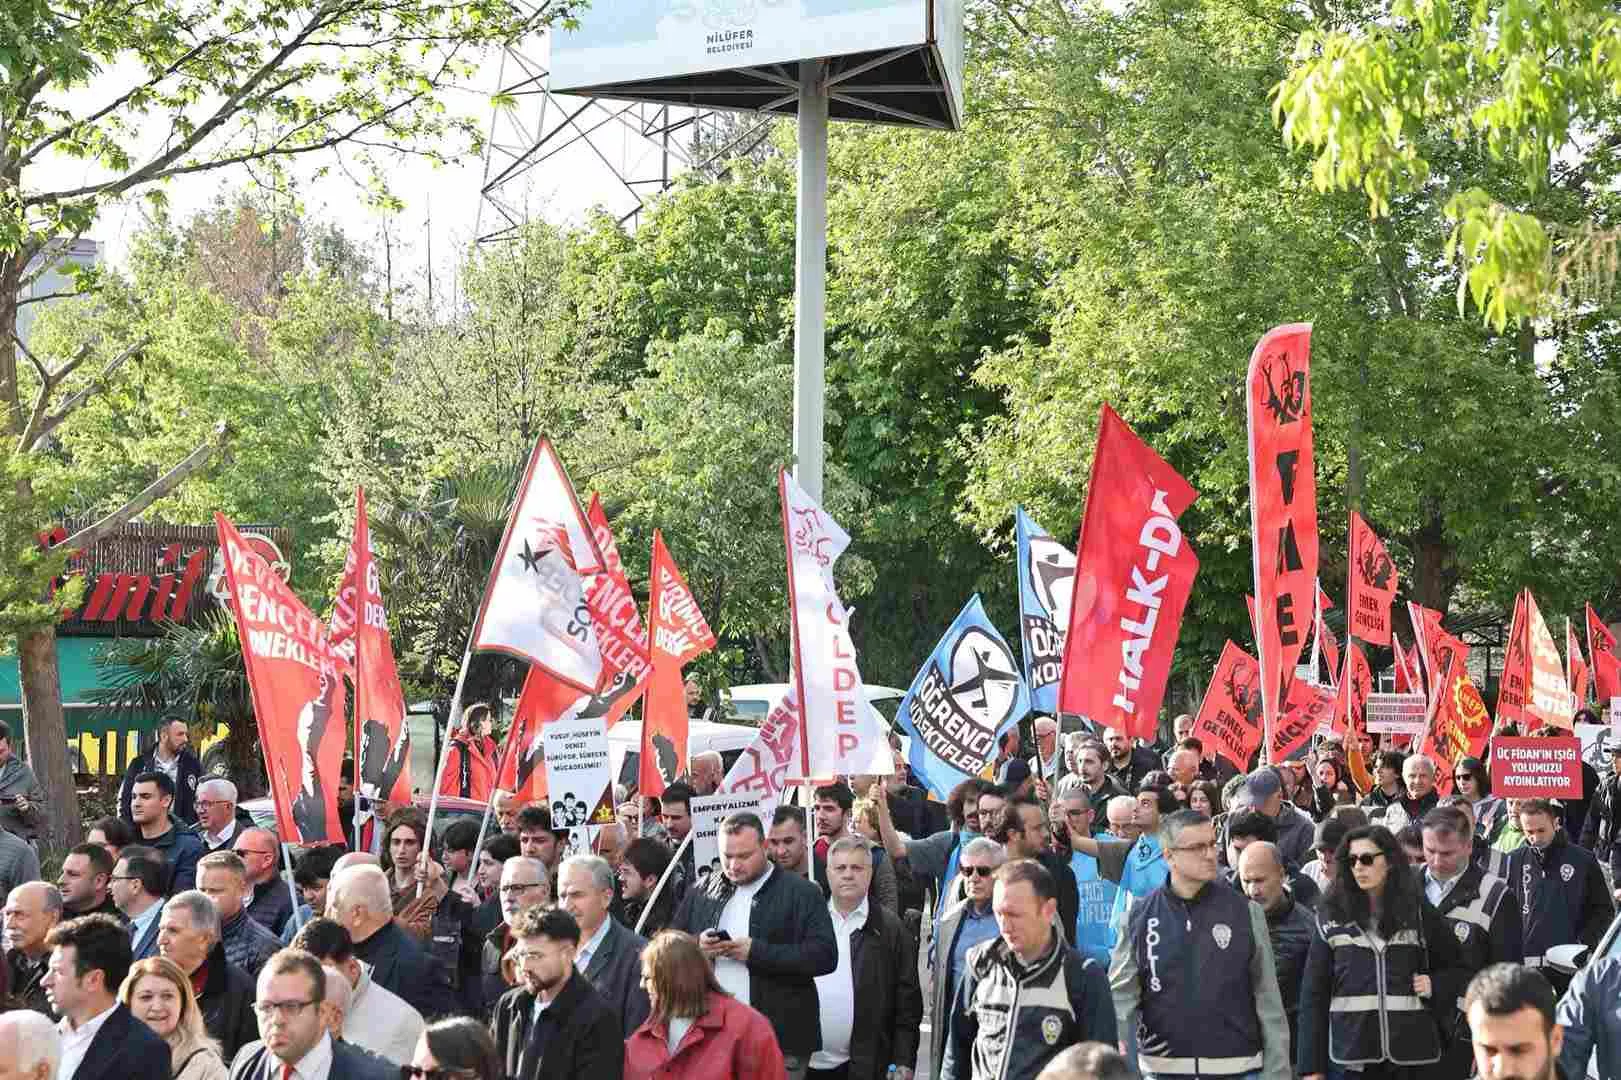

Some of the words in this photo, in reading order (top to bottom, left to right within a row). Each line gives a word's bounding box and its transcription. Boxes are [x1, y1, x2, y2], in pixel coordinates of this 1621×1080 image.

[706, 29, 753, 44] NİLÜFER
[706, 40, 753, 54] BELEDİYESİ
[920, 668, 993, 756] ÖĞRENCİ
[1216, 709, 1246, 742] EMEK
[1497, 746, 1510, 760] ÜÇ
[1554, 747, 1577, 761] IŞIĞI
[1511, 762, 1563, 774] YOLUMUZU
[1503, 774, 1571, 787] AYDINLATIYOR
